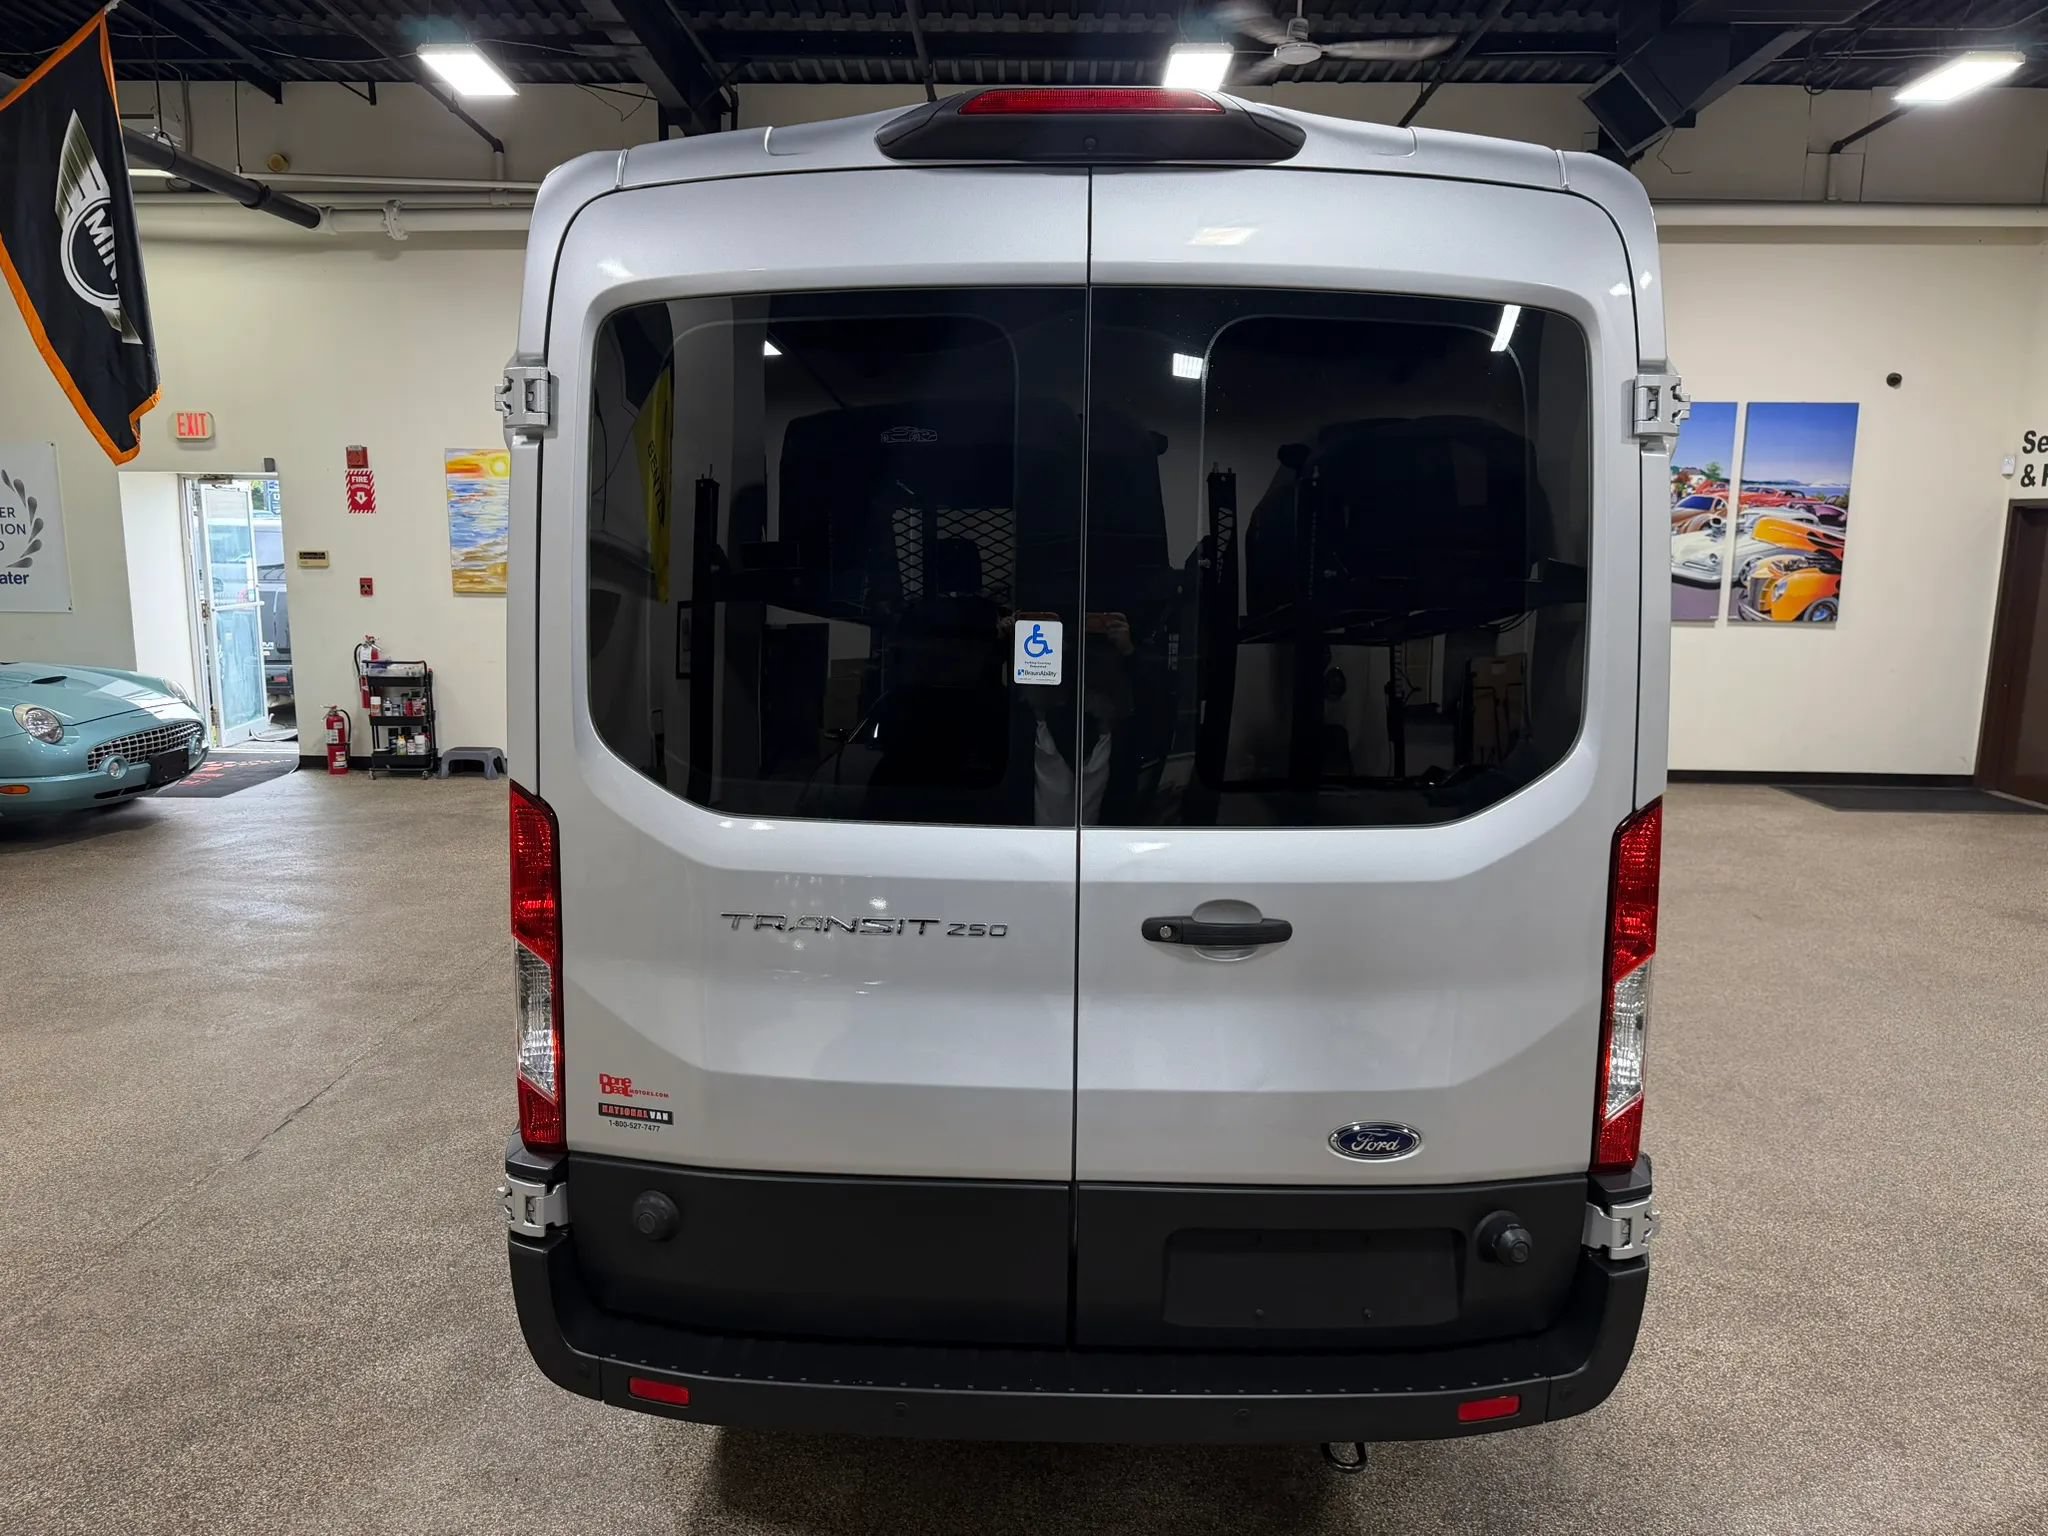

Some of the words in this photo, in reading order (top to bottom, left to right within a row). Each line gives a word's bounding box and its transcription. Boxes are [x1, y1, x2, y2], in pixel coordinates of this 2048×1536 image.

[177, 412, 207, 436] EXIT
[351, 475, 369, 483] FIRE
[2020, 464, 2036, 487] &
[720, 912, 941, 936] TRANSIT
[946, 922, 1008, 937] 250
[600, 1073, 632, 1087] Done
[609, 1119, 660, 1132] 1-800-527-7477
[1351, 1131, 1401, 1151] Ford
